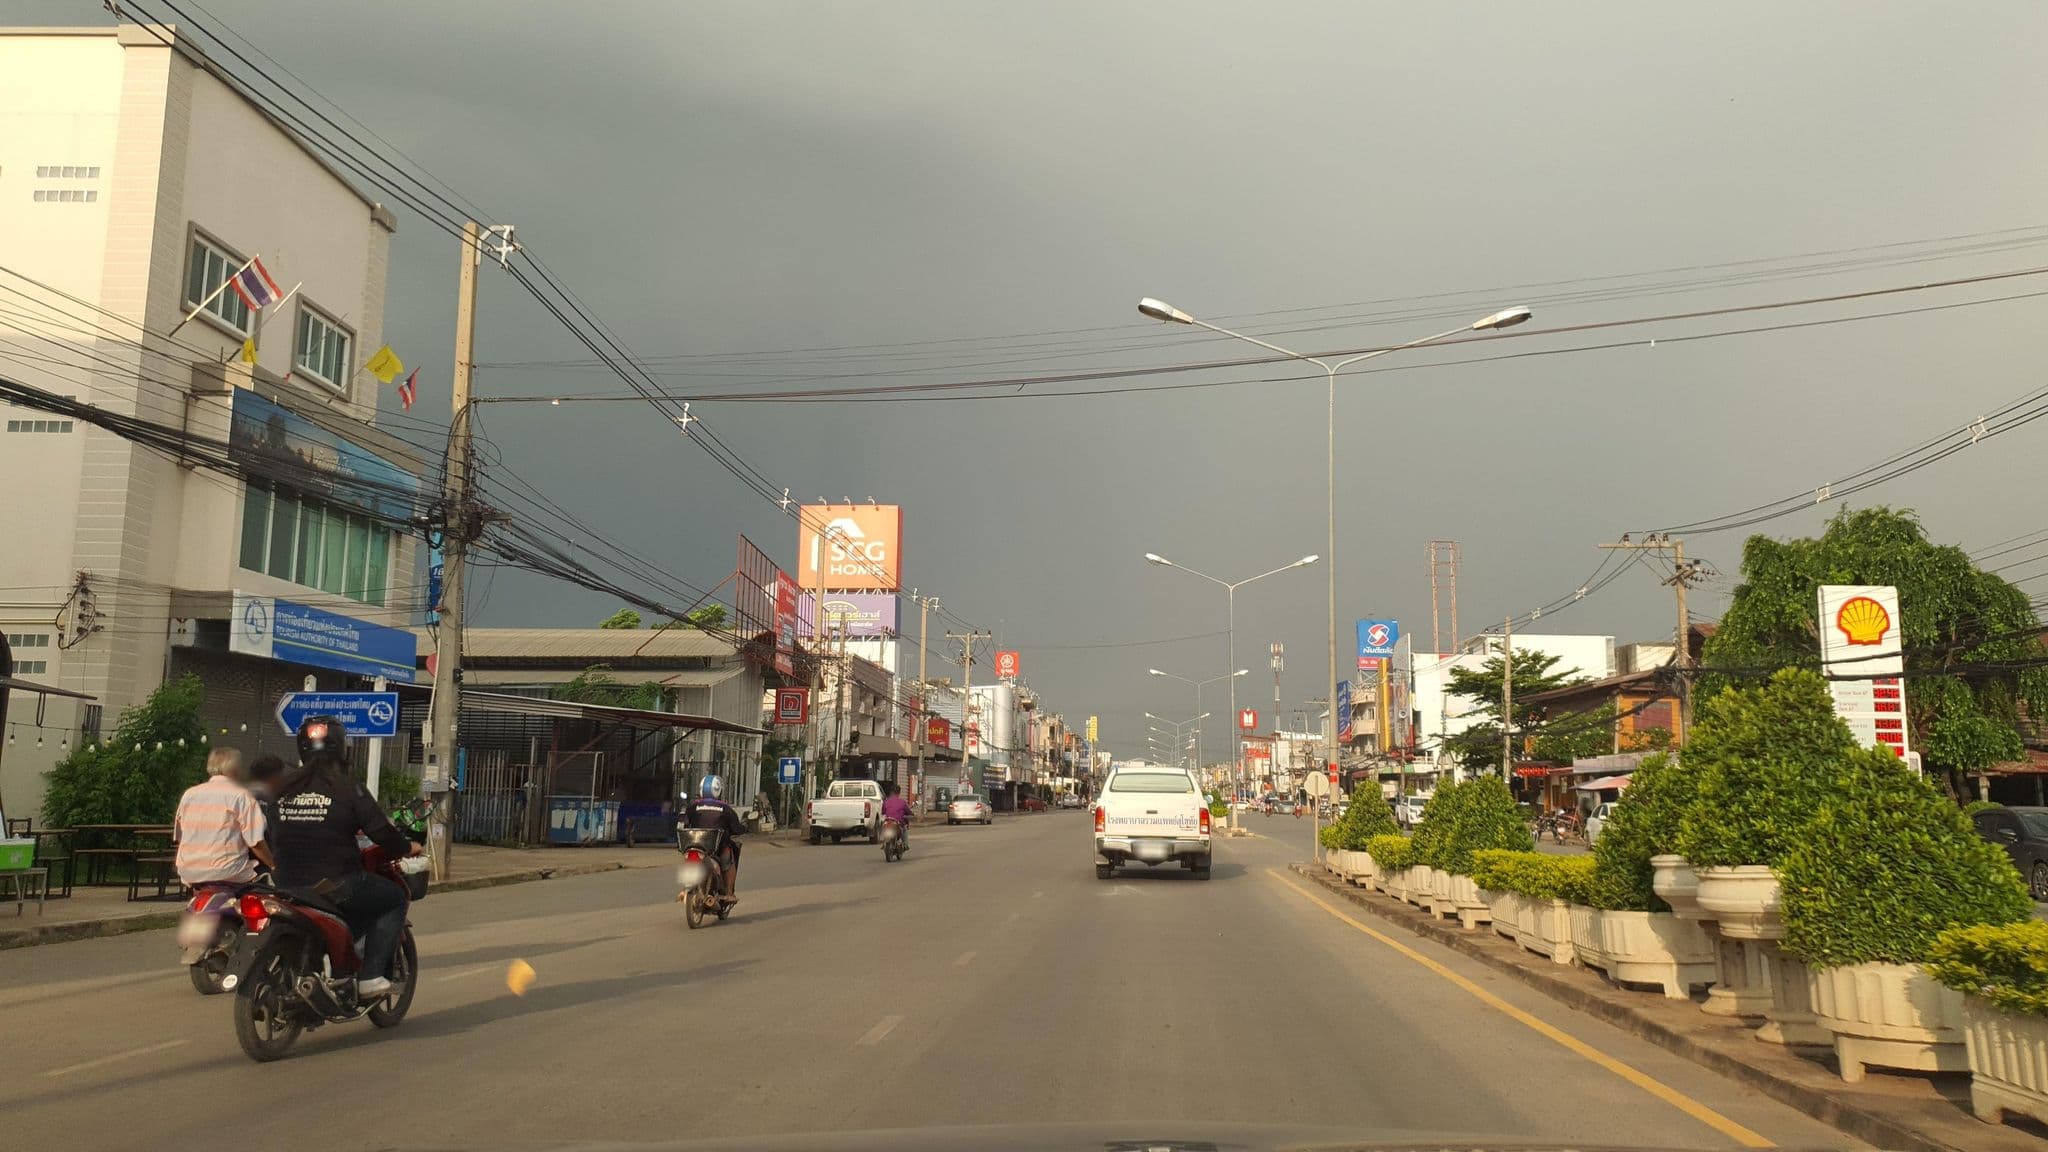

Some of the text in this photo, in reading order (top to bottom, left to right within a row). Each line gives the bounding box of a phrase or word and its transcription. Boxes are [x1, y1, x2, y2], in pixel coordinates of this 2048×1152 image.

[830, 541, 886, 561] SCG
[830, 563, 886, 577] HOME
[276, 625, 360, 652] TOURISM AUTHORITY OF THAILAND
